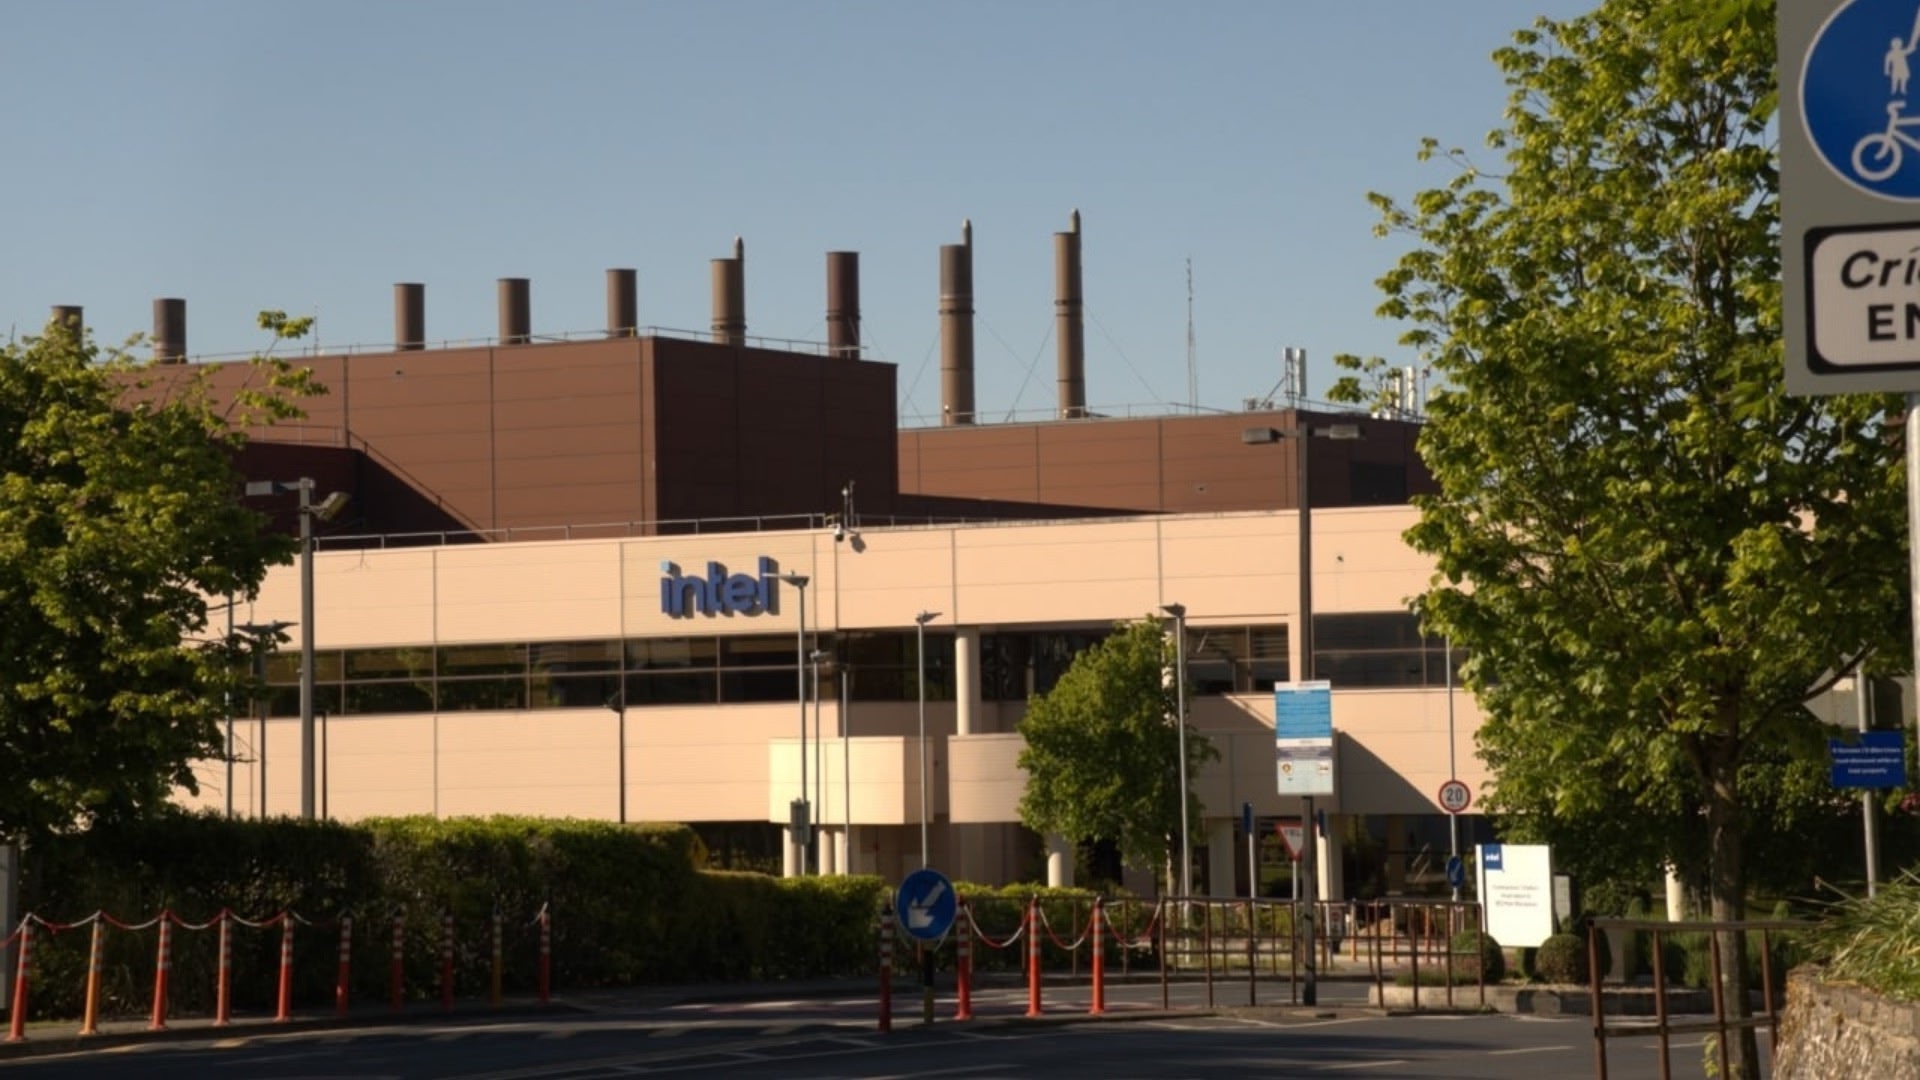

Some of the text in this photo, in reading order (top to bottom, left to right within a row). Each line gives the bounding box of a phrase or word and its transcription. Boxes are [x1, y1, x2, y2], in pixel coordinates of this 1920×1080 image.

[1840, 246, 1920, 289] Crí
[660, 555, 779, 619] intel
[1446, 787, 1463, 802] 20
